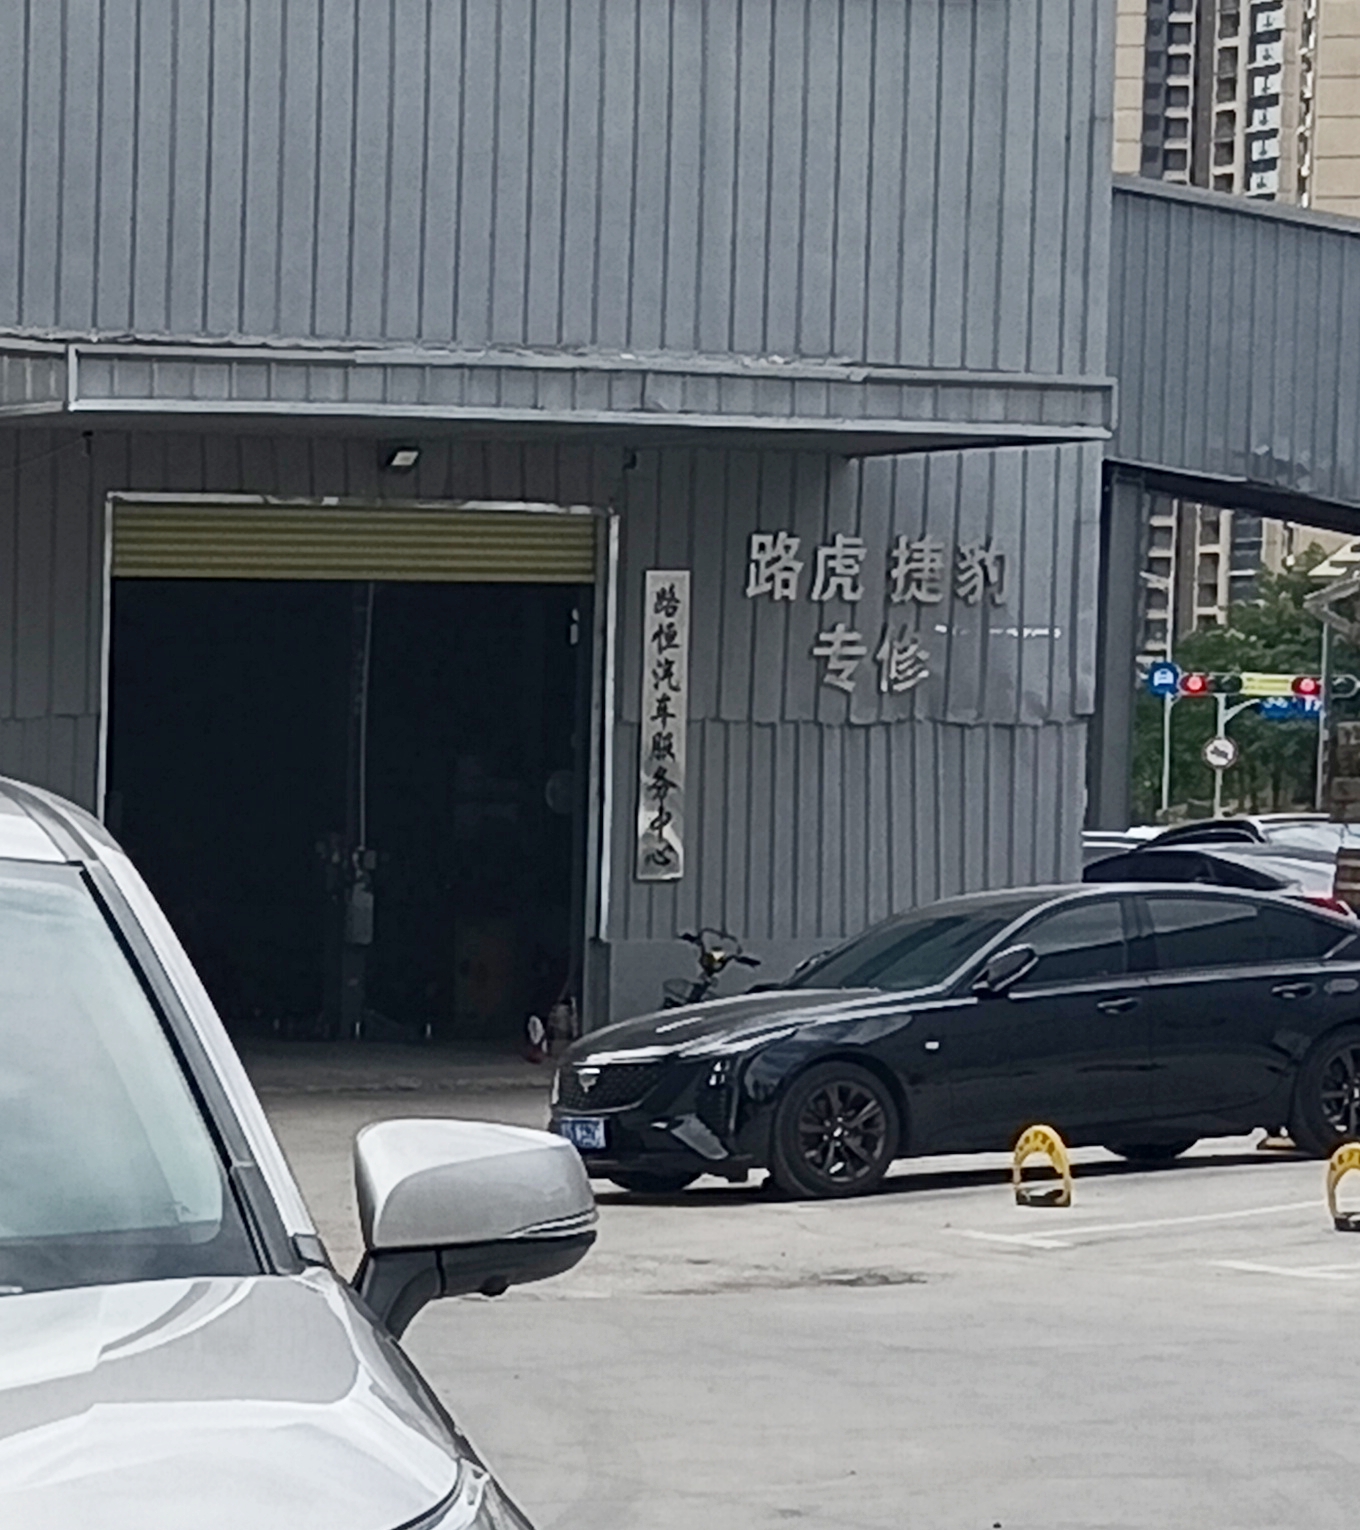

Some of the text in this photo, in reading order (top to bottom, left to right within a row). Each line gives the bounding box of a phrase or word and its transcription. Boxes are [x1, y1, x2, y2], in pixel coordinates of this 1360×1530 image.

[746, 530, 1007, 605] 路虎捷豹
[813, 622, 931, 692] 专修
